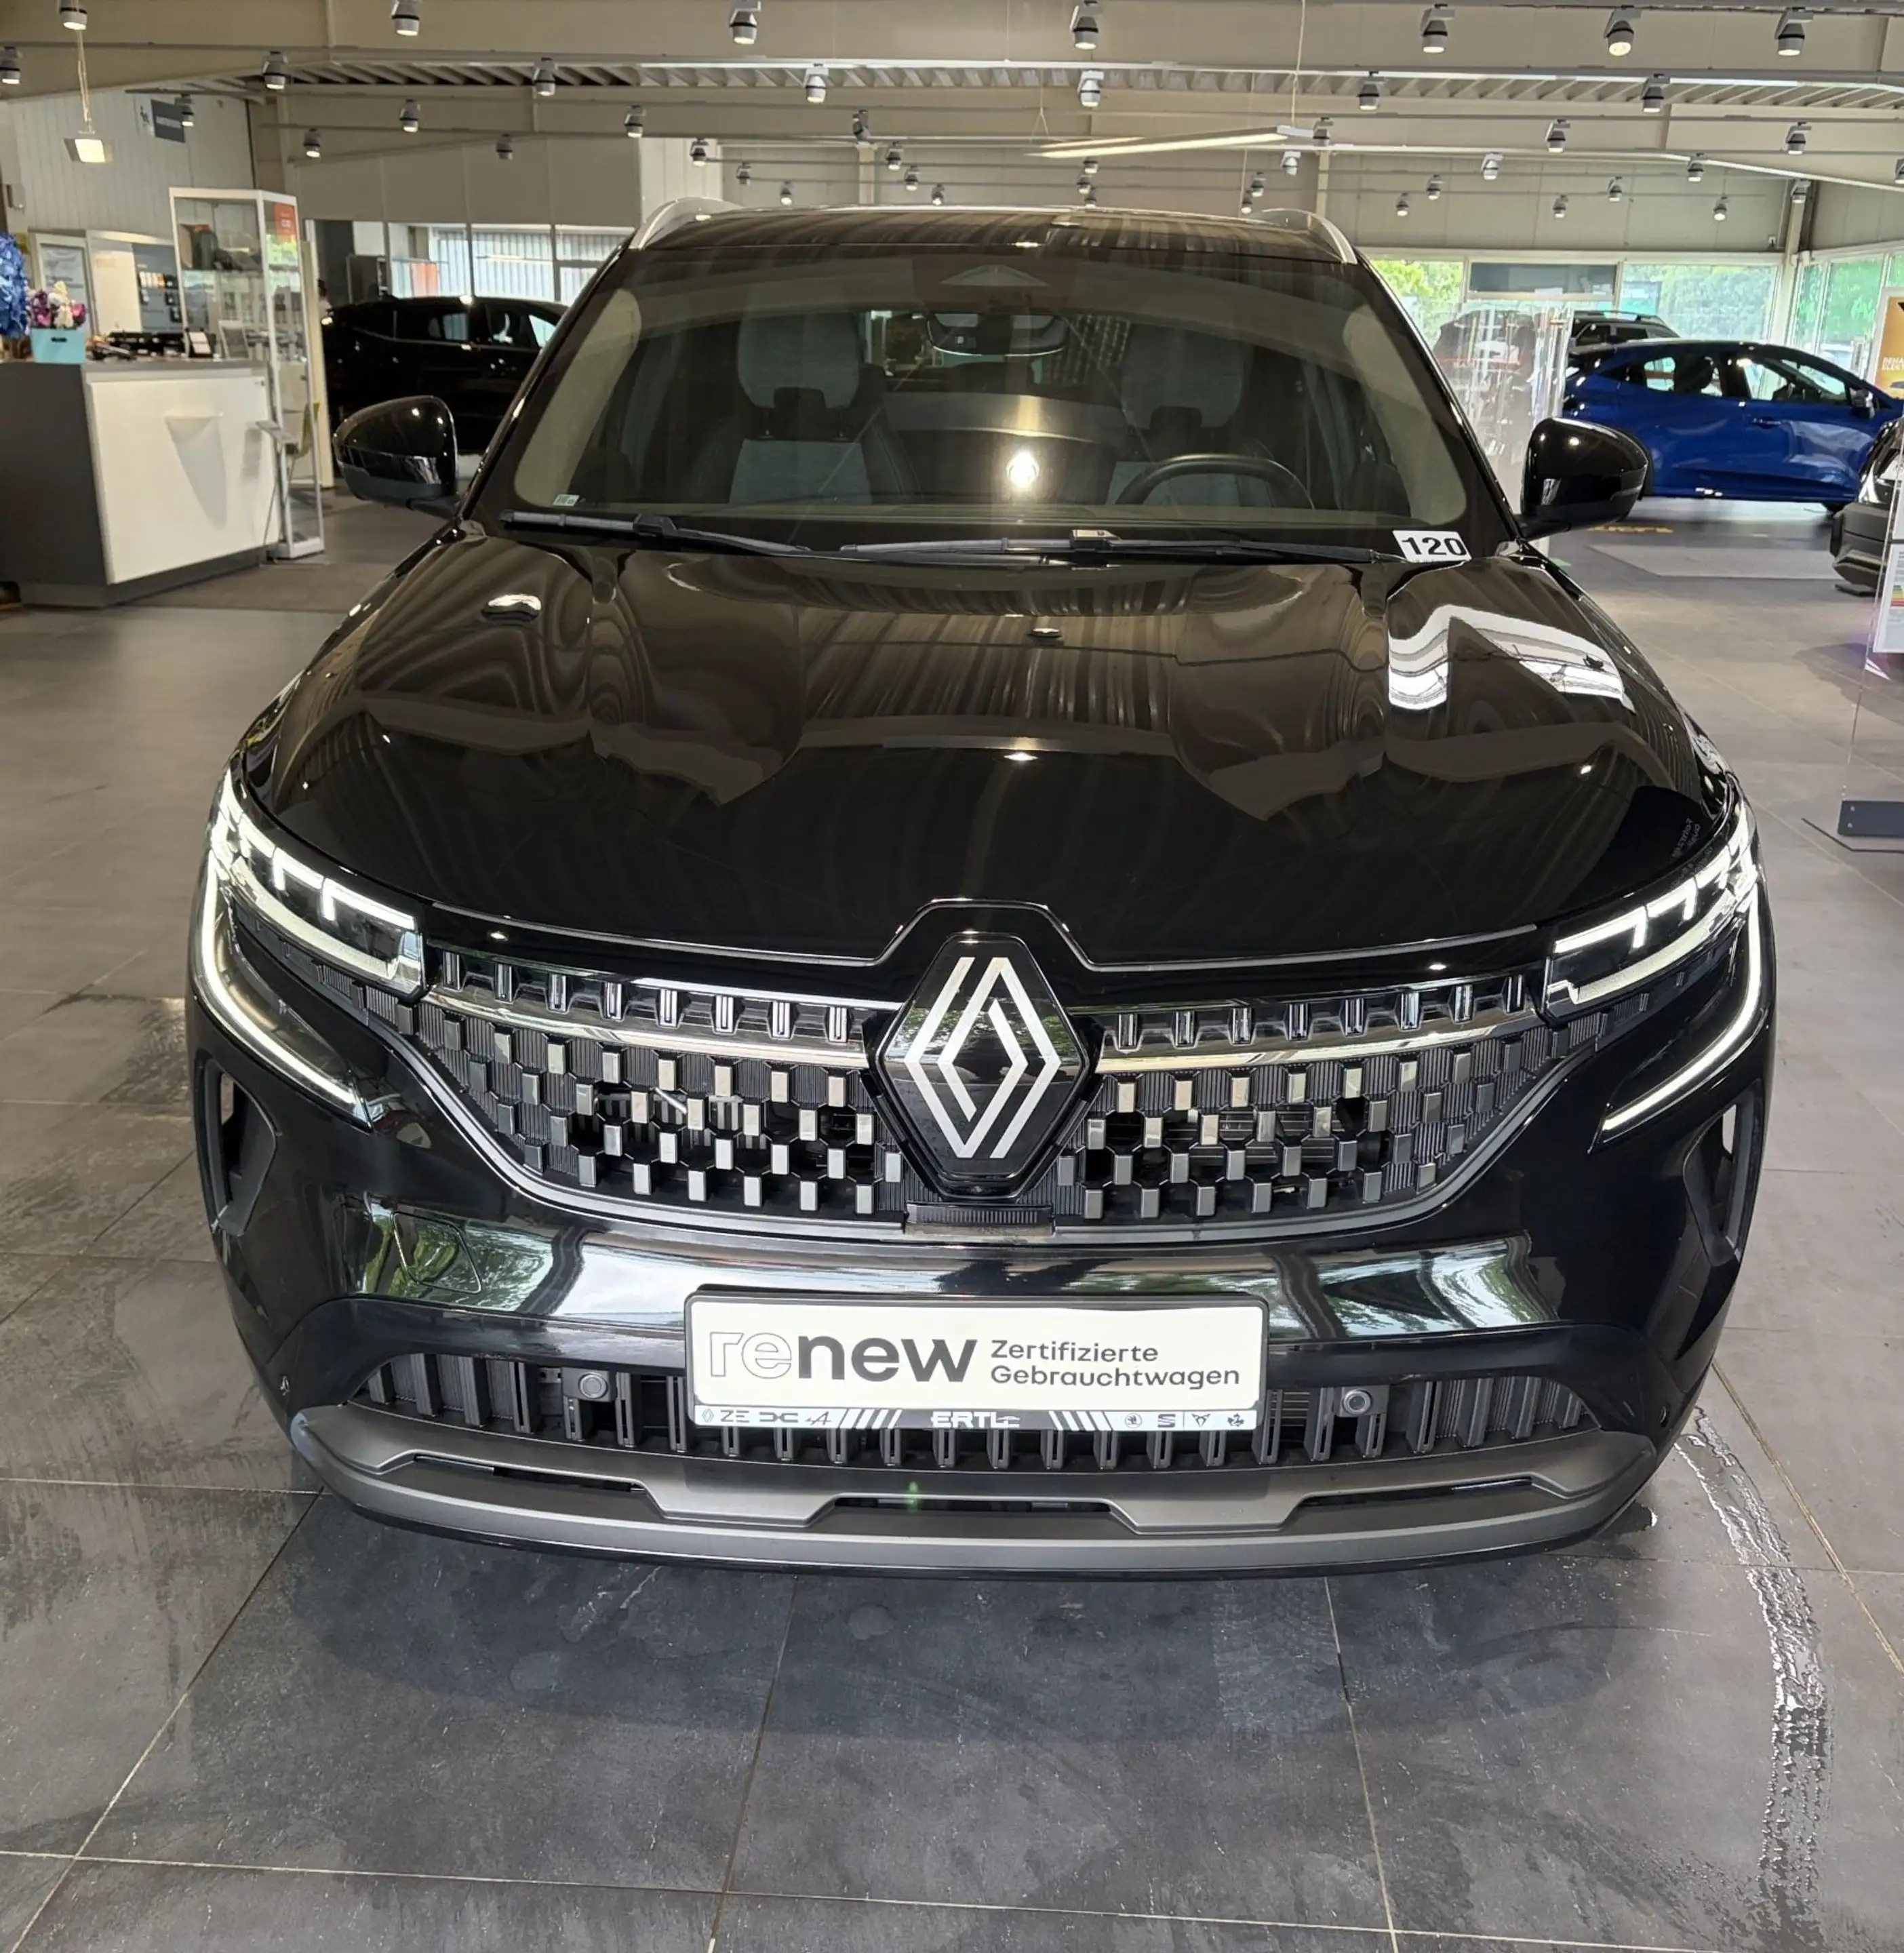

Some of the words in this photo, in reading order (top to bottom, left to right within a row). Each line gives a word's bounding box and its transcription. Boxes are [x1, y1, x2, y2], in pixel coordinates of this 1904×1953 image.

[1402, 537, 1467, 555] 120
[709, 1331, 978, 1382] renew
[991, 1339, 1159, 1362] Zertifizierte
[991, 1364, 1240, 1390] Gebrauchtwagen
